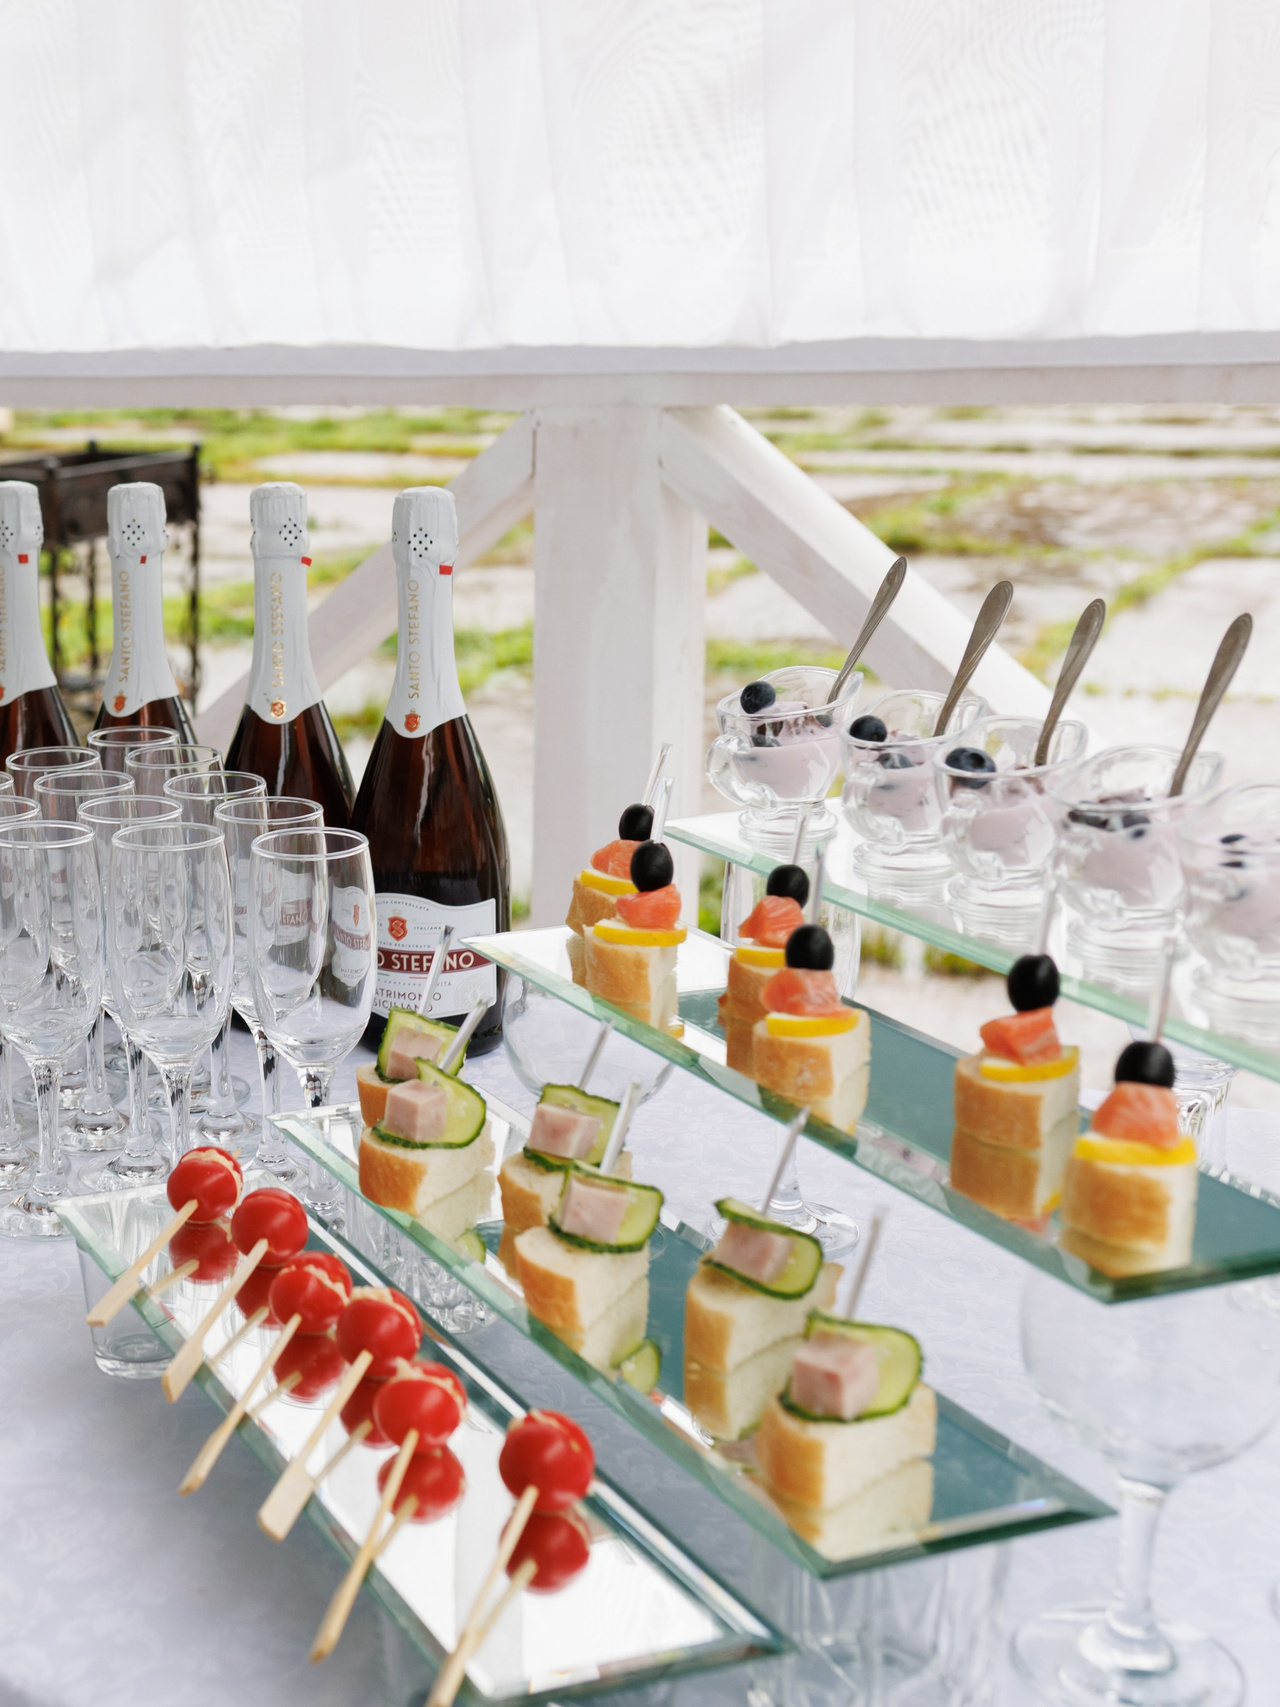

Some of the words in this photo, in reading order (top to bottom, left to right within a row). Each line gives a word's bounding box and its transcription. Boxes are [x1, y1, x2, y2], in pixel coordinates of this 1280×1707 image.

[119, 570, 131, 631] STEFANO
[270, 572, 283, 636] STEFANO
[407, 580, 420, 645] STEFANO
[119, 637, 132, 683] SANTO
[272, 641, 284, 688] SANTO
[408, 651, 420, 699] SANTO
[391, 951, 474, 971] STEFNO
